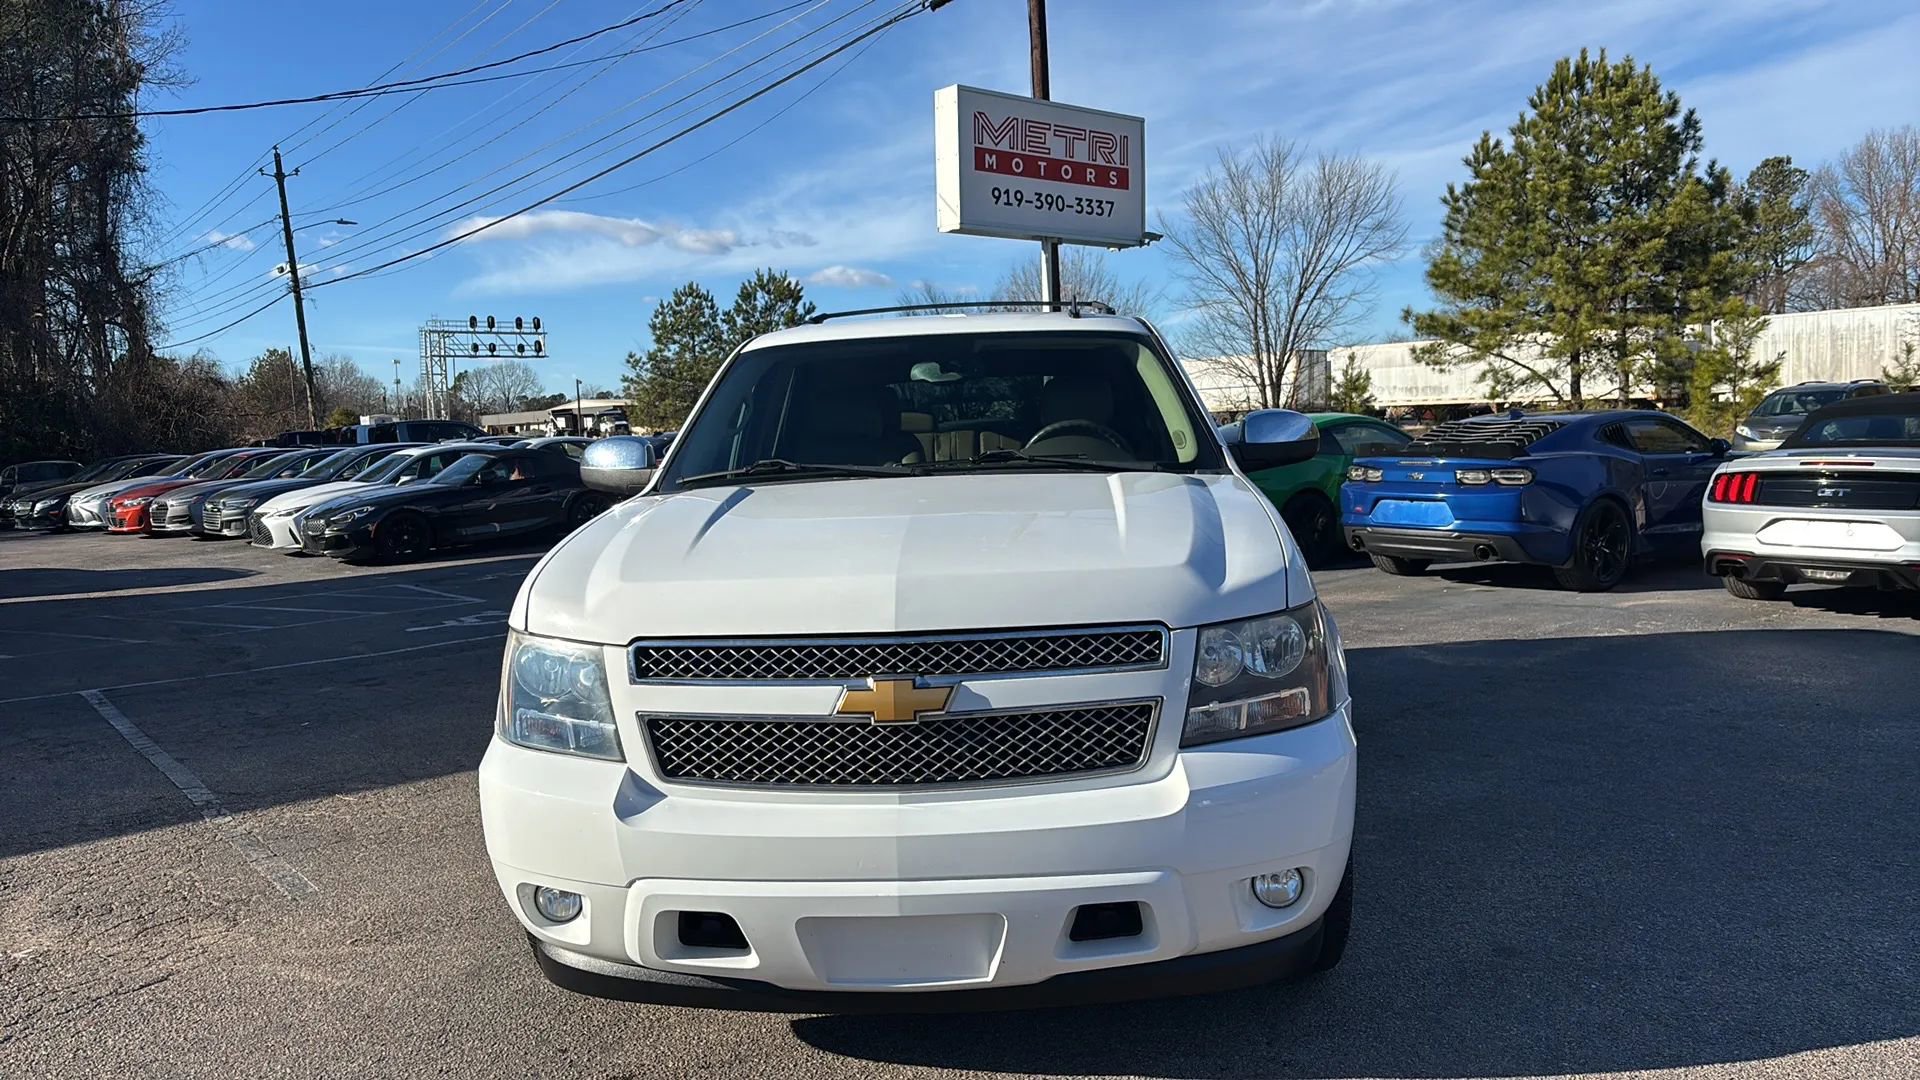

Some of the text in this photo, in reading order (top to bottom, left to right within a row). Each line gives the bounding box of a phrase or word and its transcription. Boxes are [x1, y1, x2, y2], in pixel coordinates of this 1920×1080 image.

[973, 111, 1129, 166] METRI
[985, 153, 1118, 186] MOTORS
[991, 187, 1115, 217] 919-390-3337
[1817, 488, 1851, 497] GT
